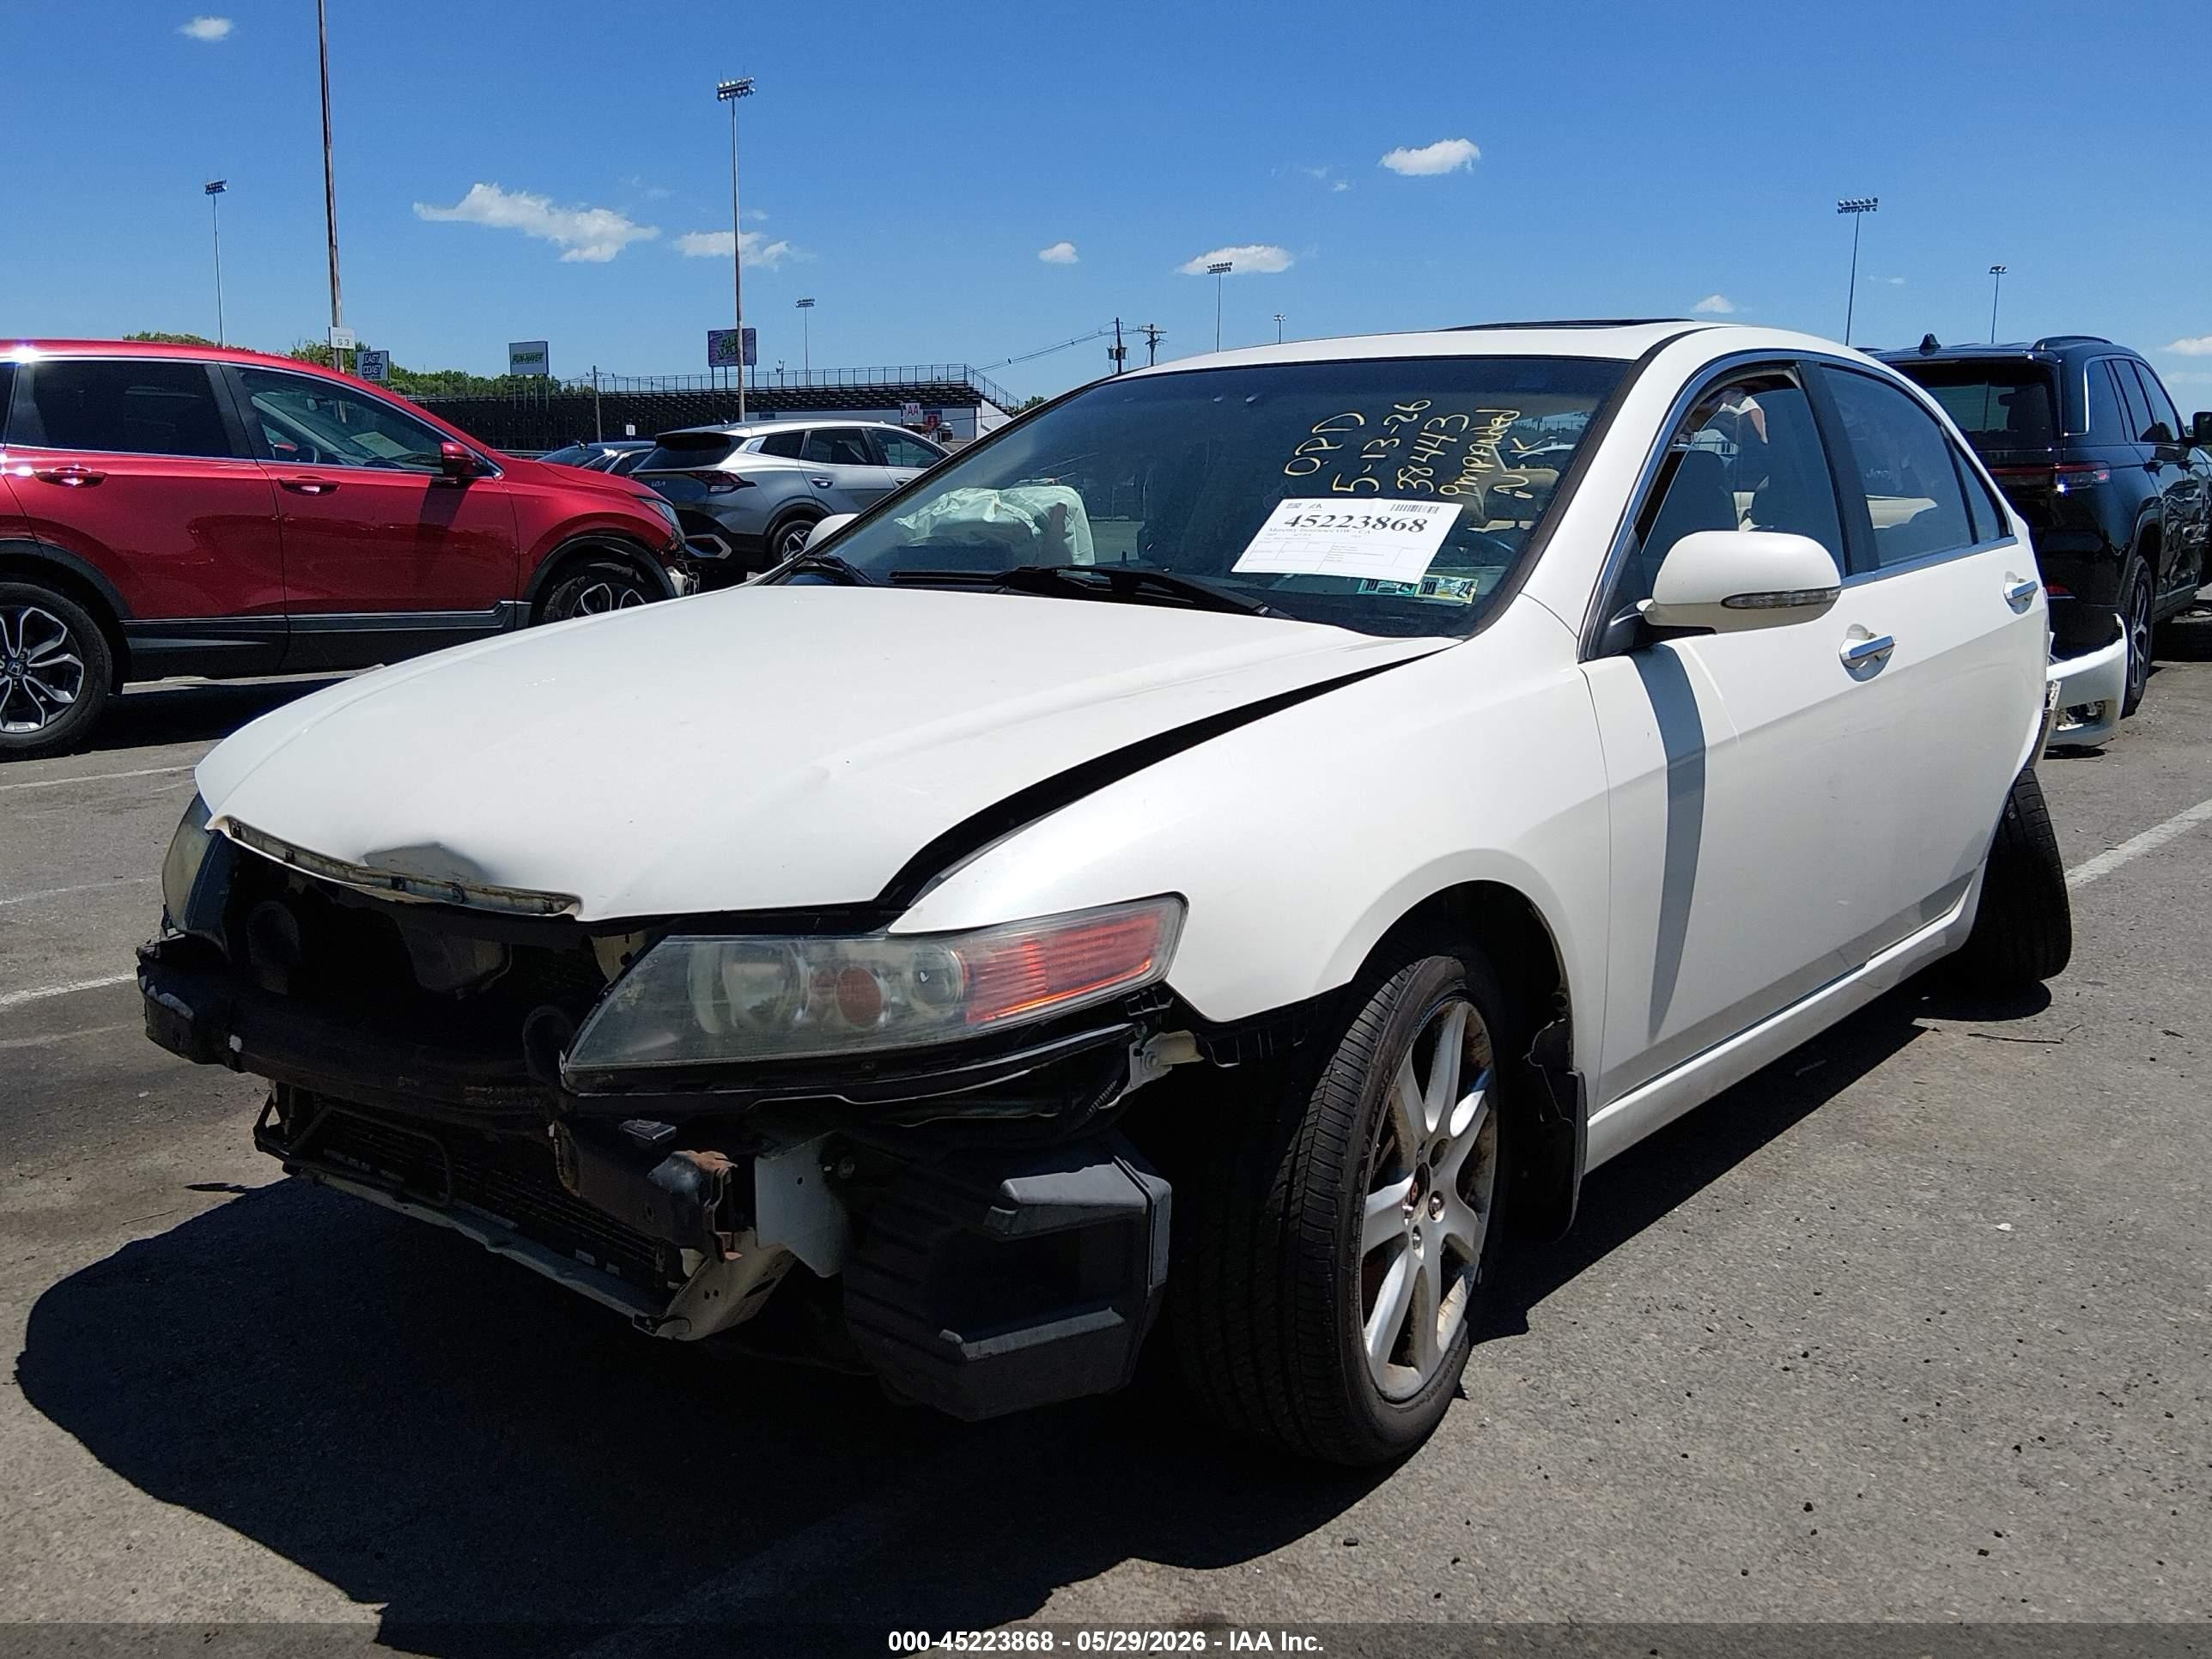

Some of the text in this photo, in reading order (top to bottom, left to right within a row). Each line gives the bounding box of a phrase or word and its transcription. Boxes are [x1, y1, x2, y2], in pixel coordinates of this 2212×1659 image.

[364, 354, 380, 364] EAST
[362, 364, 382, 374] COAST
[1284, 514, 1428, 533] 45223868
[1423, 580, 1437, 594] 10
